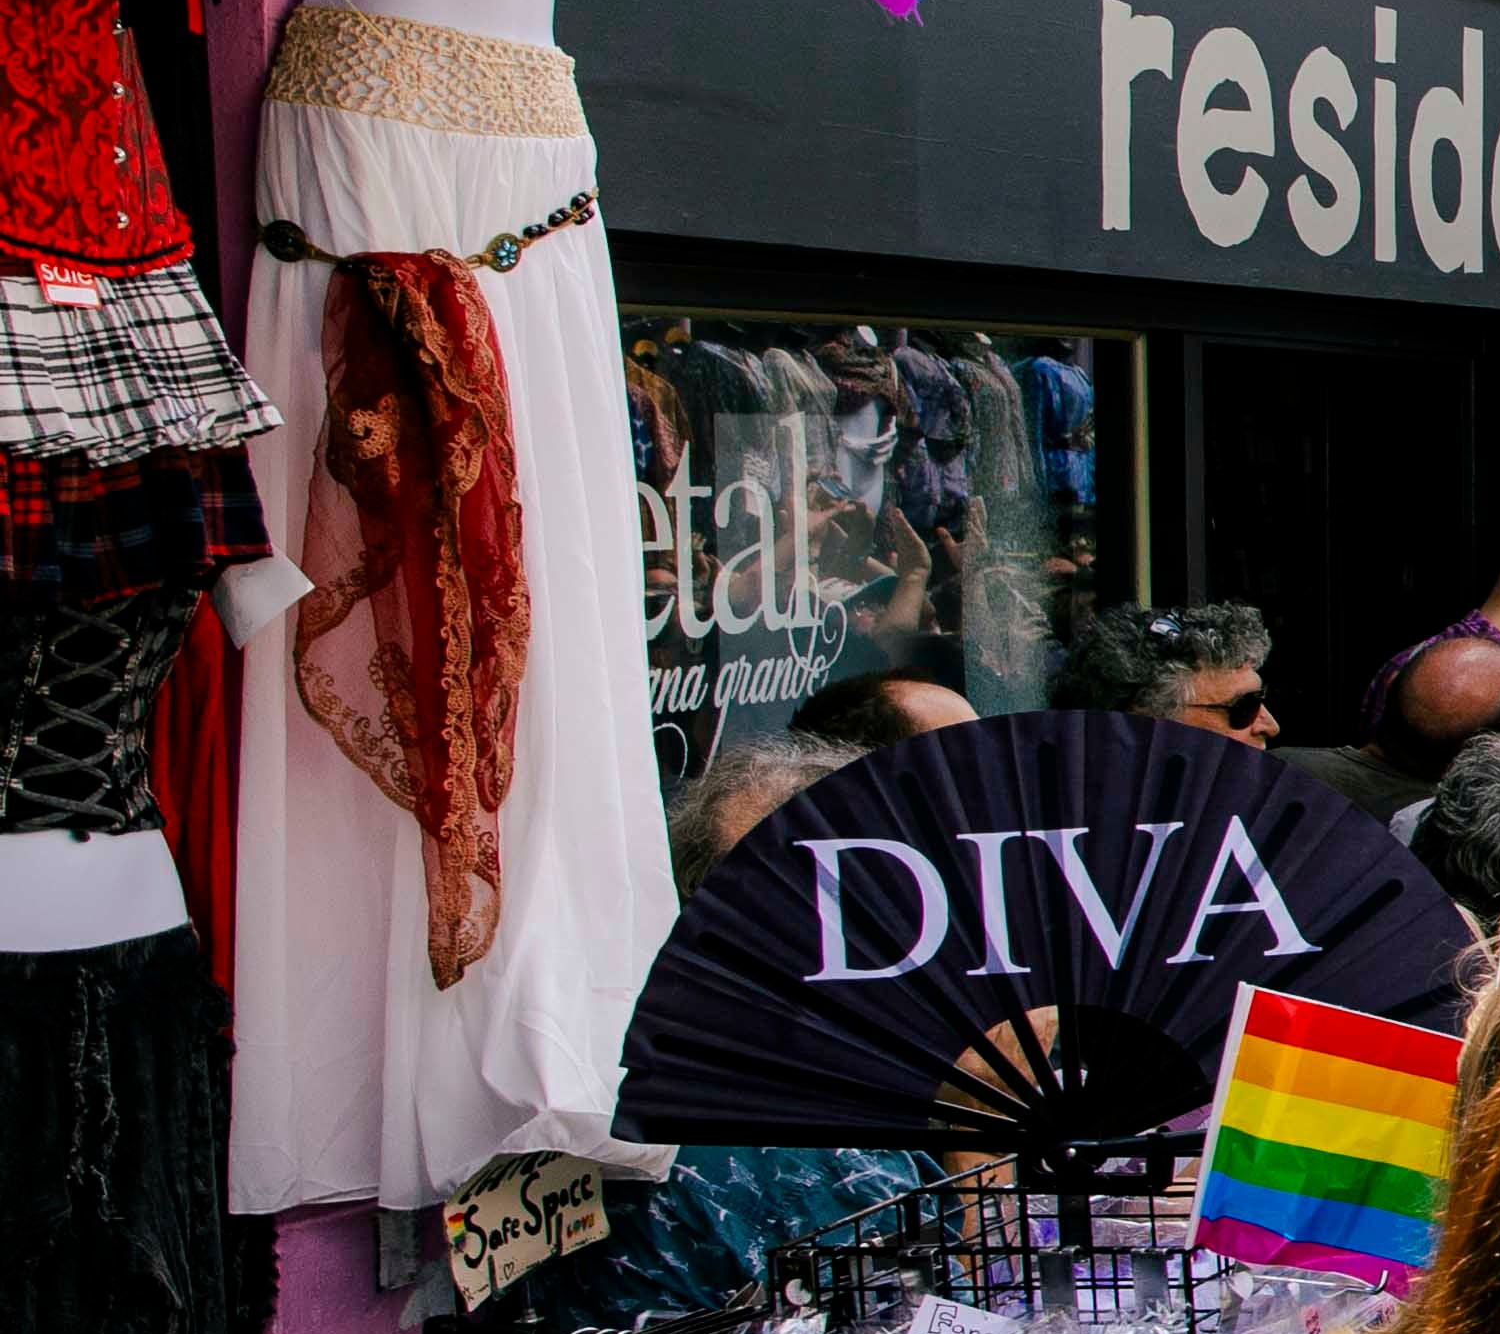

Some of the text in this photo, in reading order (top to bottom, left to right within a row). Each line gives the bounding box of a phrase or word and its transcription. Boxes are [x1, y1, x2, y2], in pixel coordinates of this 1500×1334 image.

[792, 814, 1323, 982] DIVA
[463, 1204, 521, 1269] Safe
[519, 1170, 596, 1247] Space
